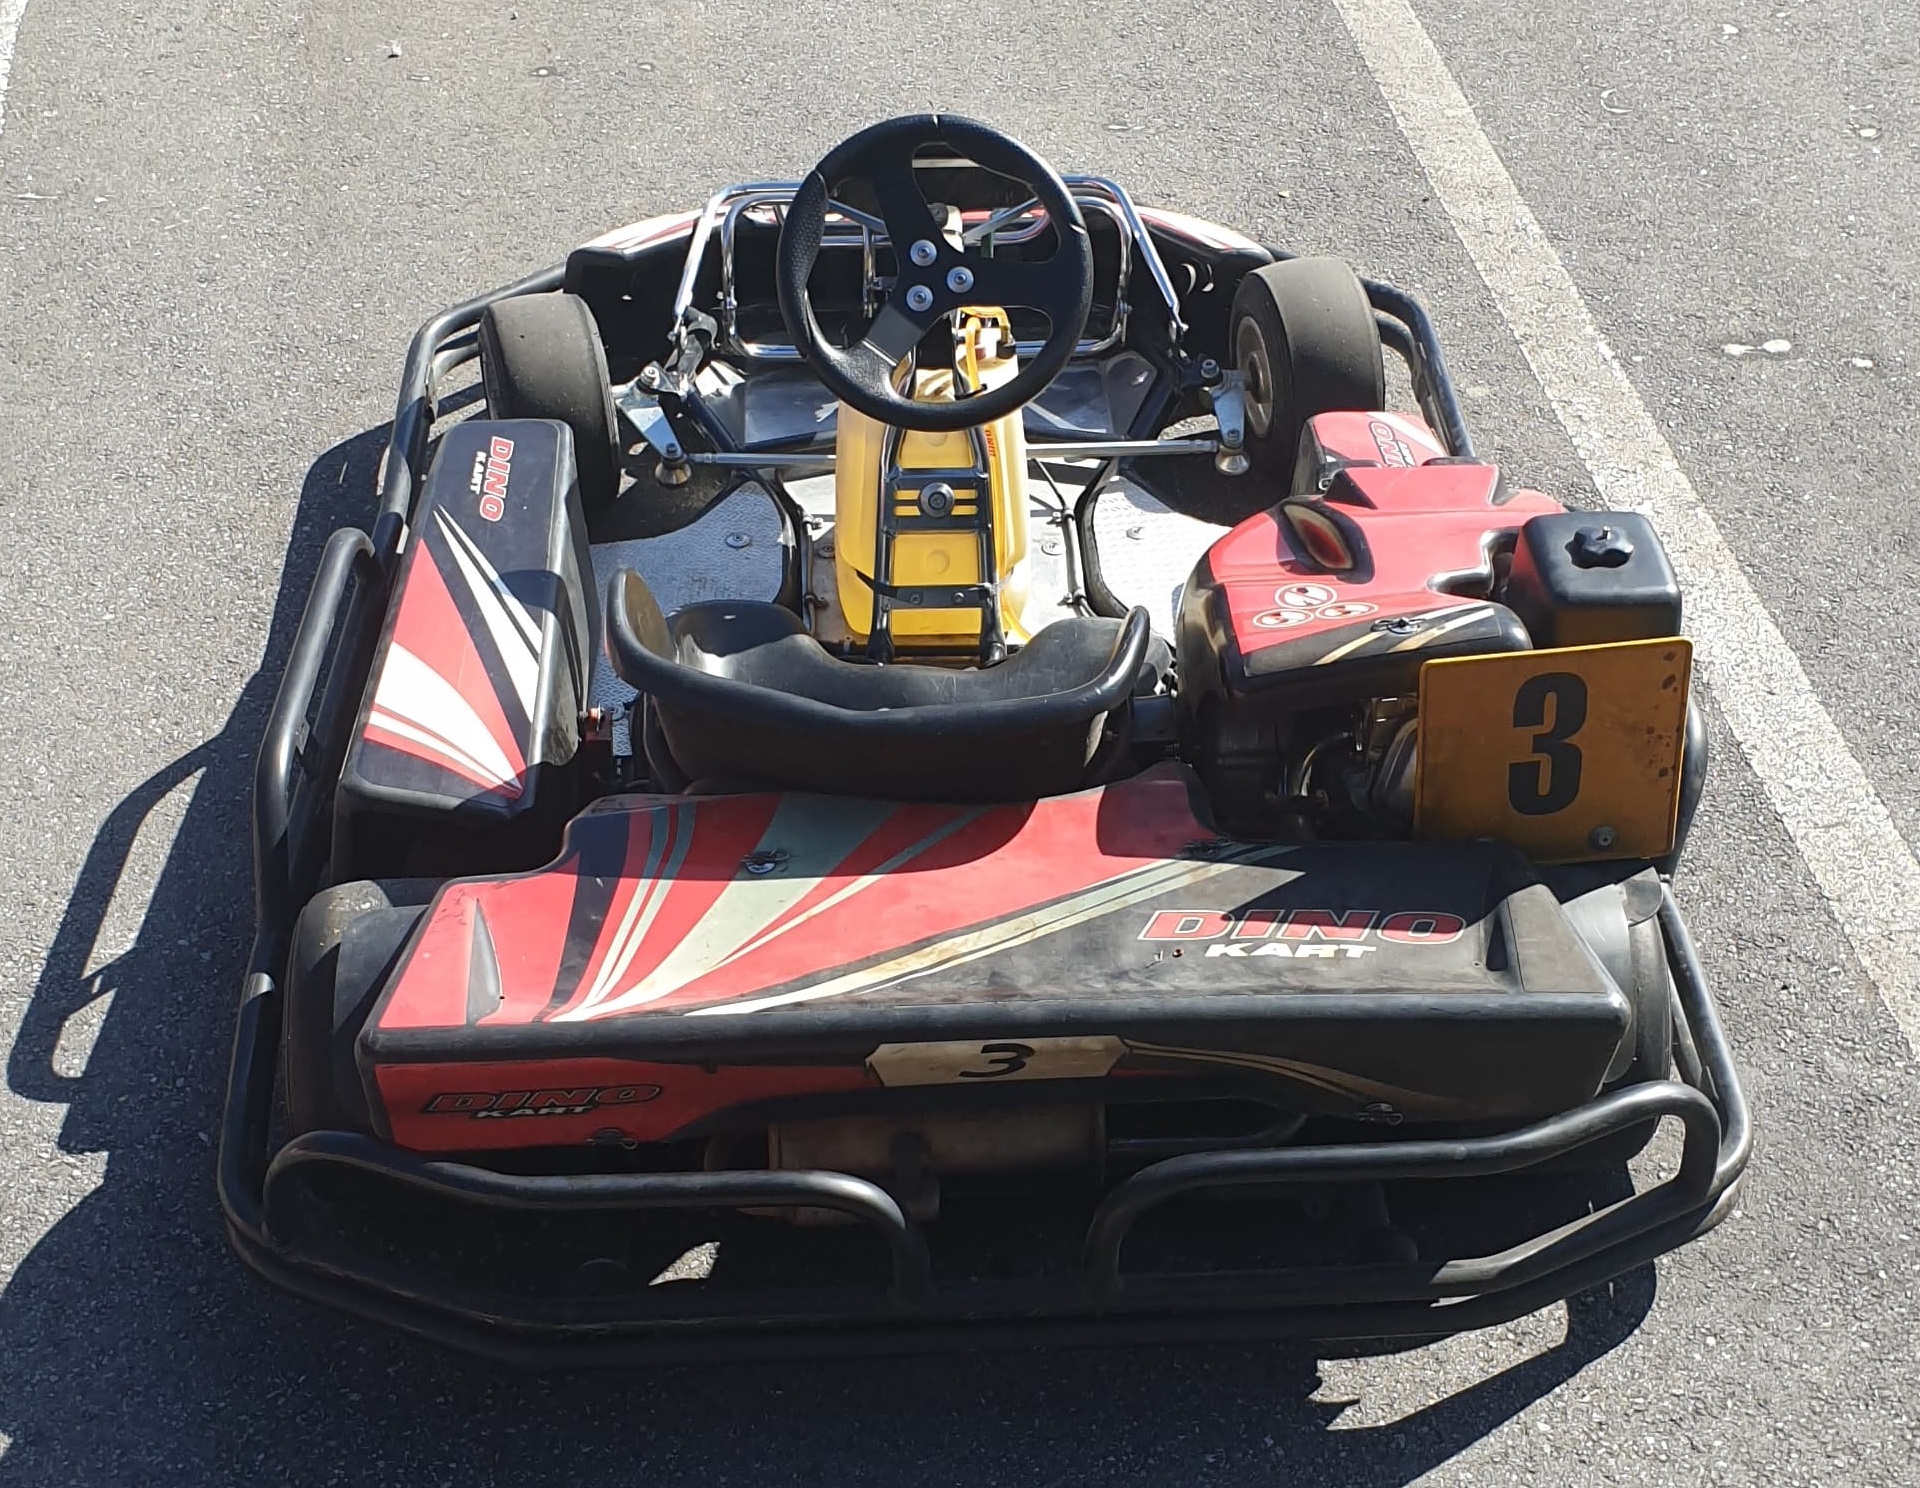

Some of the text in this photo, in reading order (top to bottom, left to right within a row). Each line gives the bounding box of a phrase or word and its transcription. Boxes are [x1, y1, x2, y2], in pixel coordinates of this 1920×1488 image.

[1369, 421, 1407, 467] INO
[470, 451, 487, 494] KART
[480, 436, 514, 522] DINO
[1508, 672, 1588, 816] 3
[1137, 909, 1467, 945] DINO
[1204, 942, 1377, 958] KART
[958, 1042, 1035, 1078] 3
[423, 1084, 662, 1113] DINO
[475, 1104, 595, 1119] KART
